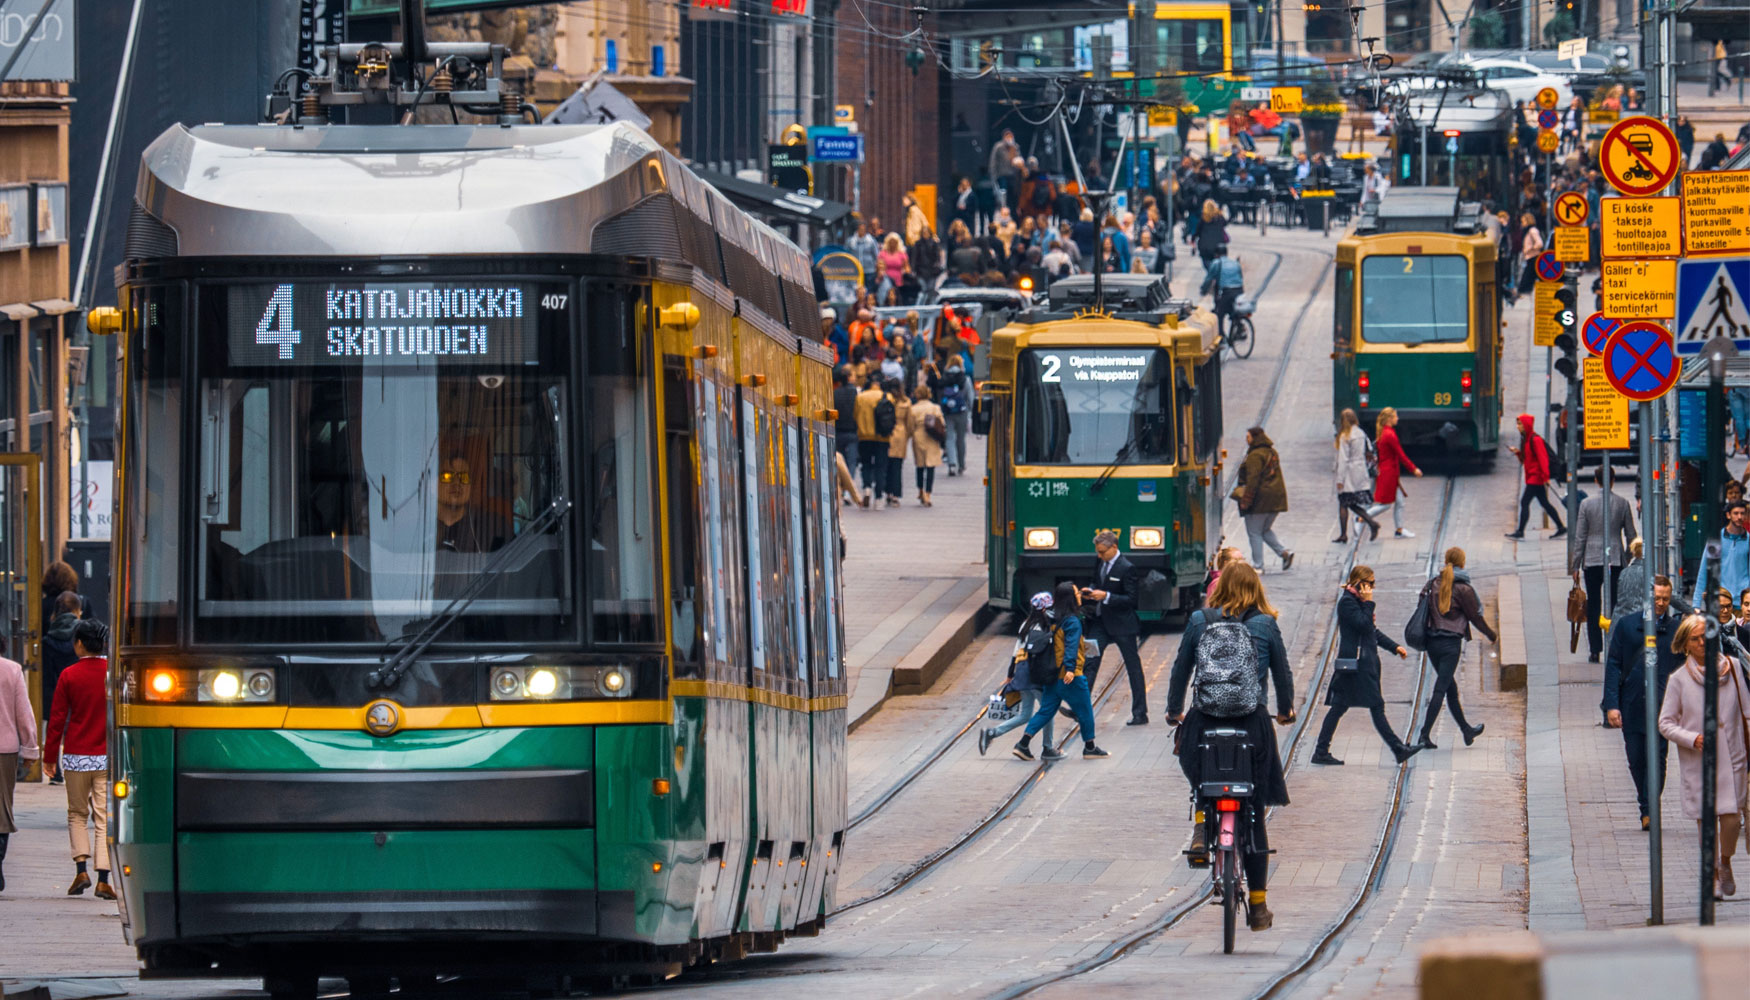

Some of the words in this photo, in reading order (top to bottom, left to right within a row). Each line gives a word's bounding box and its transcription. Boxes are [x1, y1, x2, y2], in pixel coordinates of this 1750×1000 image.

[1272, 94, 1283, 110] 10
[1542, 135, 1555, 147] 20
[1686, 174, 1749, 185] Pysäyttäminen
[1687, 197, 1716, 206] sallittu
[1613, 204, 1621, 213] Ei
[1626, 203, 1653, 213] koske
[1690, 217, 1732, 228] purkaville
[1691, 227, 1741, 239] ajoneuvoille
[1402, 257, 1414, 273] 2
[1605, 265, 1632, 275] Gäller
[1637, 265, 1646, 276] ej
[255, 284, 301, 360] 4
[326, 288, 524, 319] KATAJANOKKA
[542, 295, 568, 310] 407
[326, 325, 488, 356] SKATUDDEN
[1042, 354, 1061, 382] 2
[1074, 370, 1088, 380] via
[1090, 370, 1139, 382] Kauppatori
[1434, 392, 1452, 406] 89
